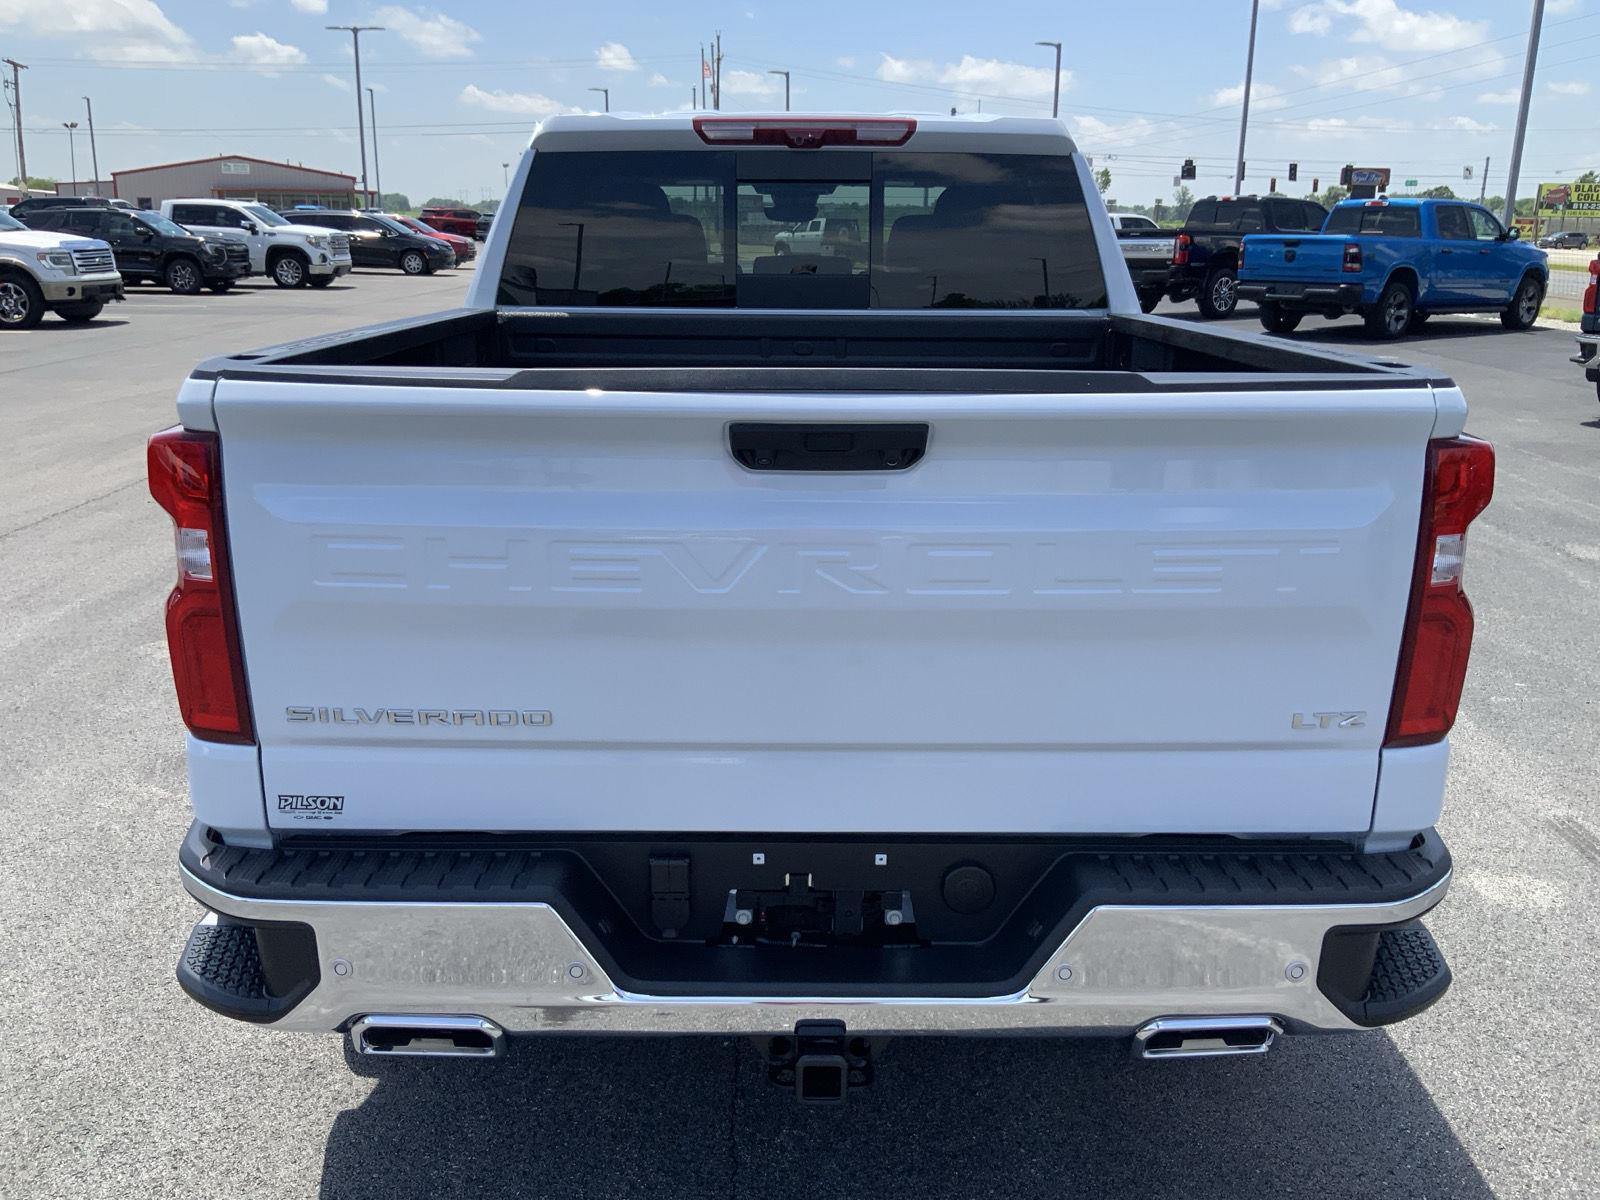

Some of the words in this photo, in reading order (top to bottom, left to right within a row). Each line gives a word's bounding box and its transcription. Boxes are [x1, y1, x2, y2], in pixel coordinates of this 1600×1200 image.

[312, 535, 1341, 596] CHEVROLET
[286, 706, 553, 727] SILVERADO
[1291, 711, 1367, 730] LTZ
[278, 795, 345, 811] PILSON
